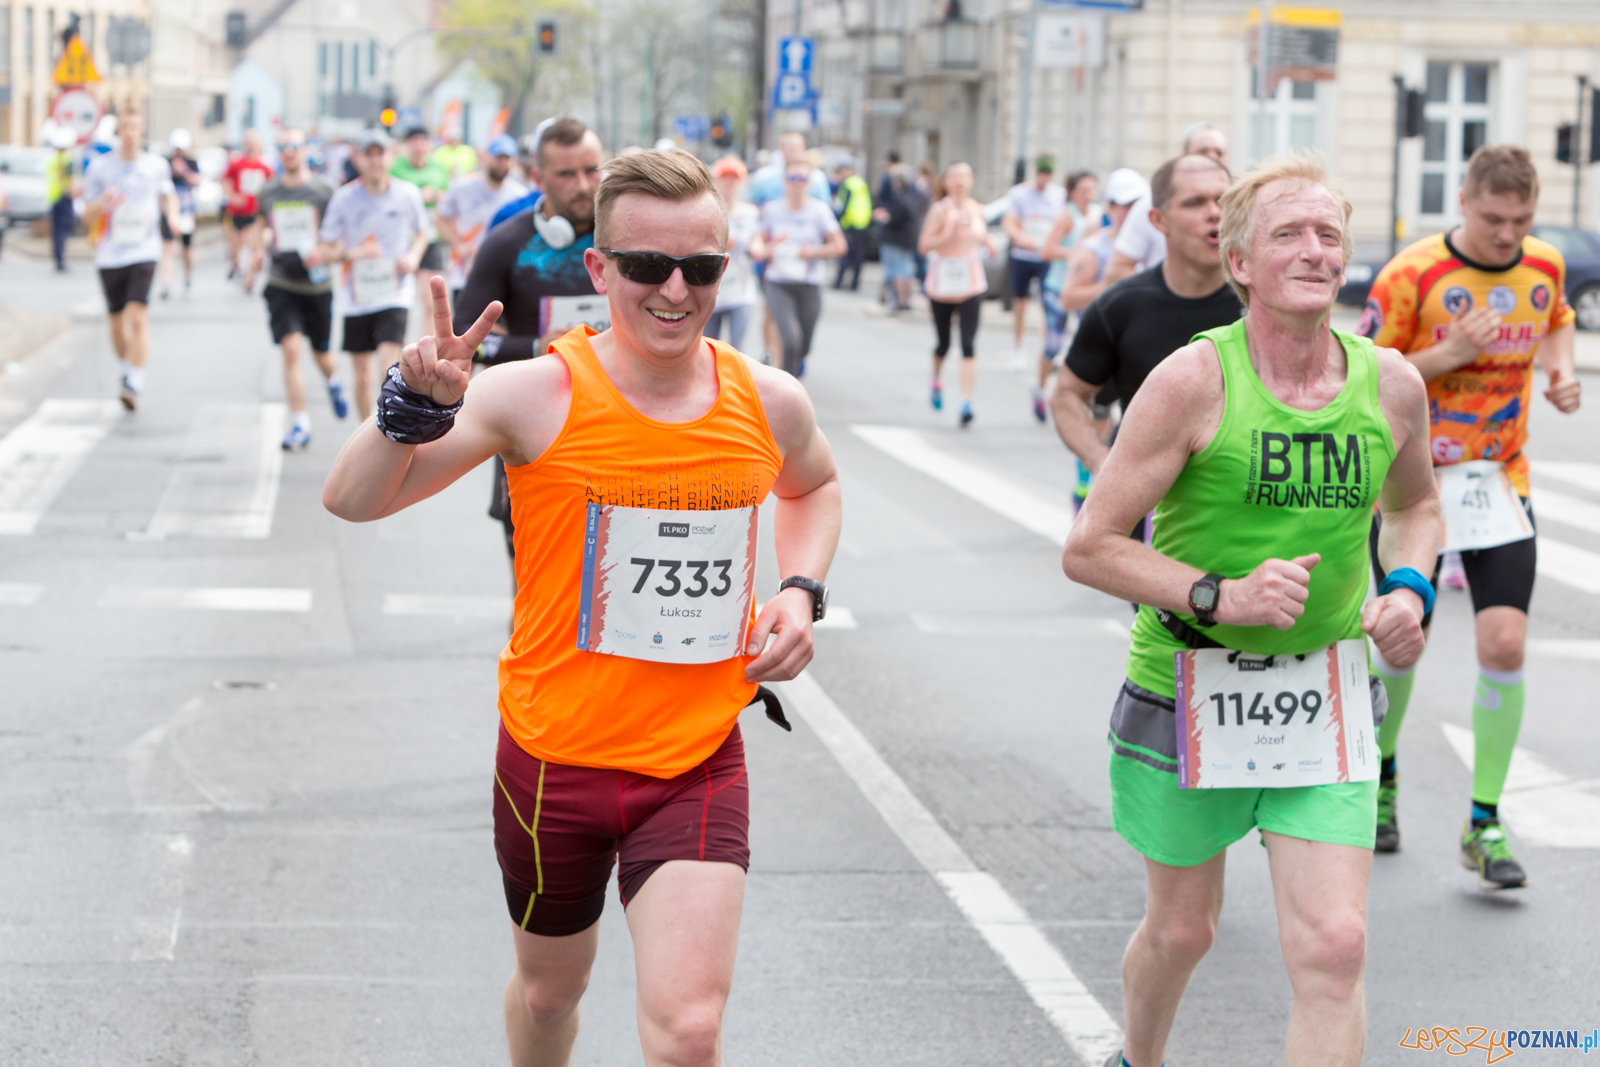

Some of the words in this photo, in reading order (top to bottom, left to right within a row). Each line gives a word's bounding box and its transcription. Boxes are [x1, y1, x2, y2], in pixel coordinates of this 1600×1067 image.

[1249, 456, 1257, 480] razem
[1260, 431, 1361, 484] BTM
[1256, 483, 1361, 508] RUNNERS
[671, 526, 687, 534] PKO
[630, 557, 733, 598] 7333
[660, 606, 702, 618] Łukasz
[1209, 690, 1322, 726] 11499
[1254, 734, 1285, 745] Józef
